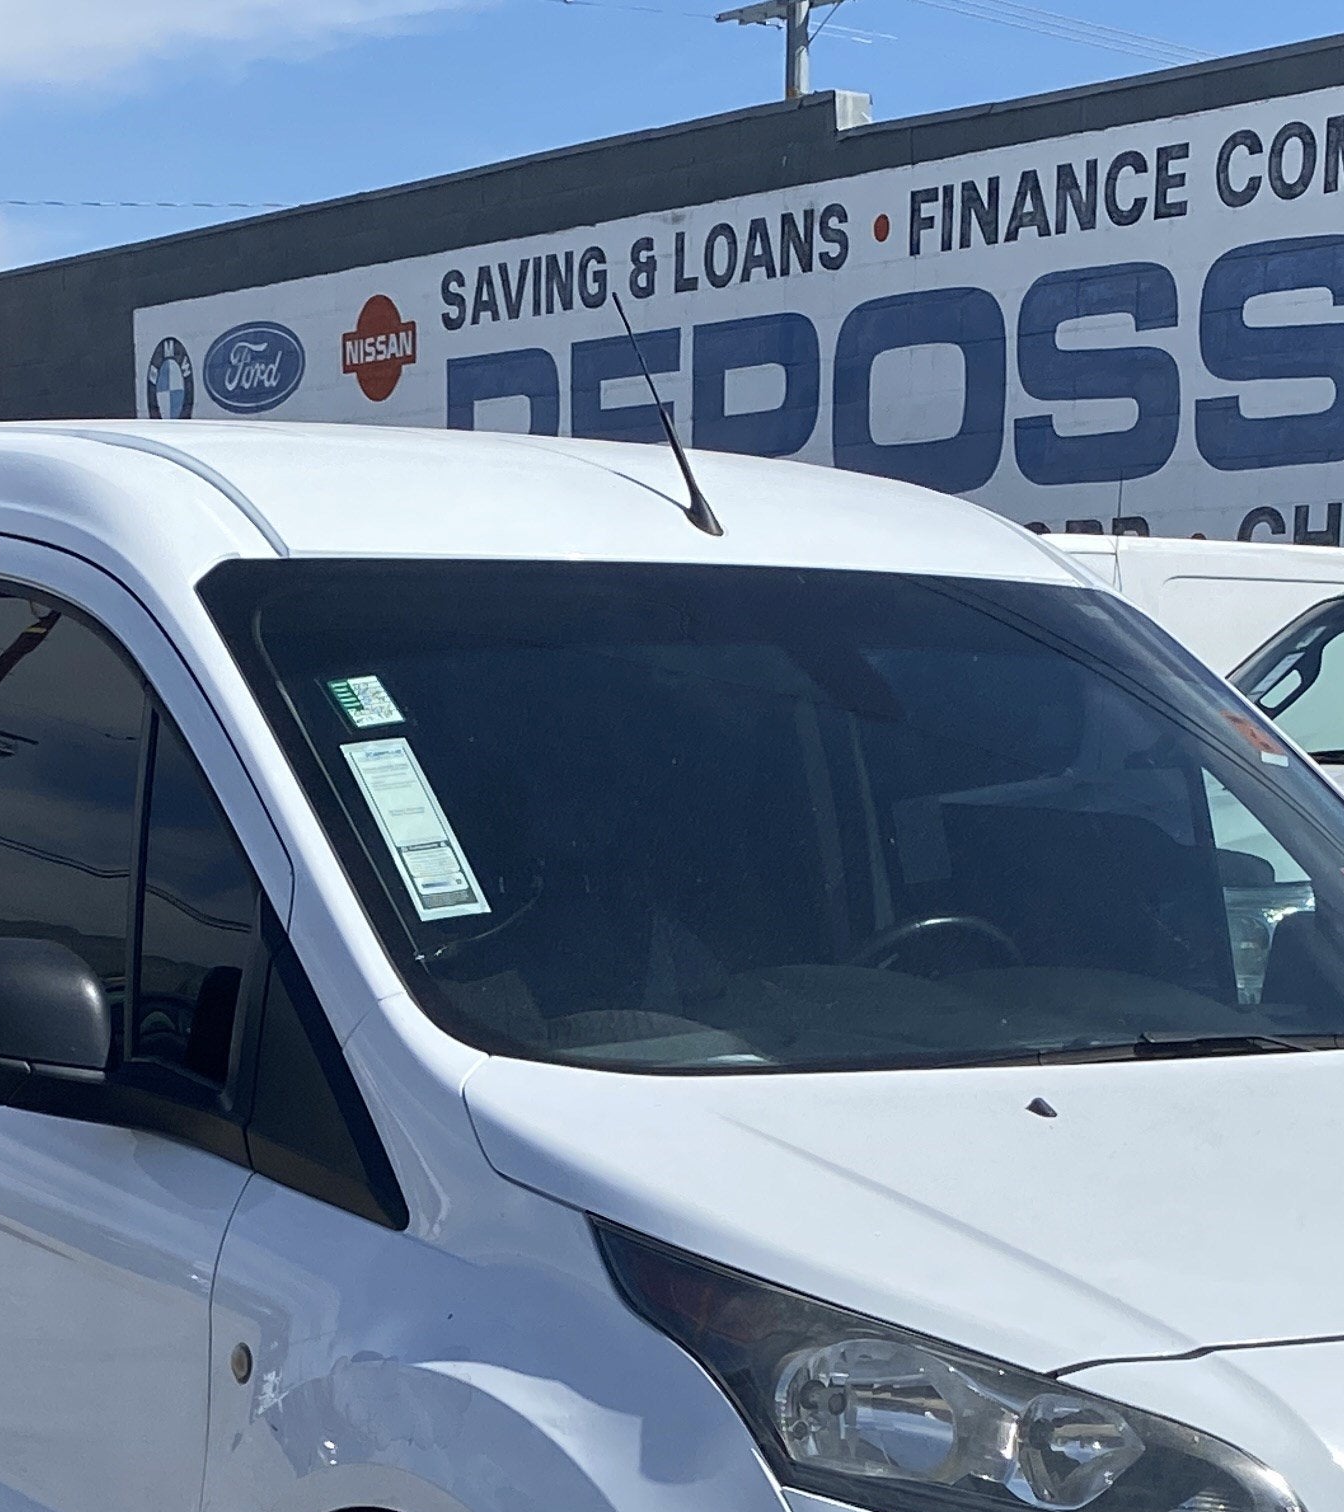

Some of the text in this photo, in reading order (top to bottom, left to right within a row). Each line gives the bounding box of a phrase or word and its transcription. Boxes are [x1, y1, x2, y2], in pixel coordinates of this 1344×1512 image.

[441, 246, 607, 331] SAVING
[630, 237, 657, 299] &
[675, 203, 850, 293] LOANS
[908, 143, 1190, 256] FINANCE
[224, 341, 282, 391] Ford
[345, 329, 413, 366] NISSAN
